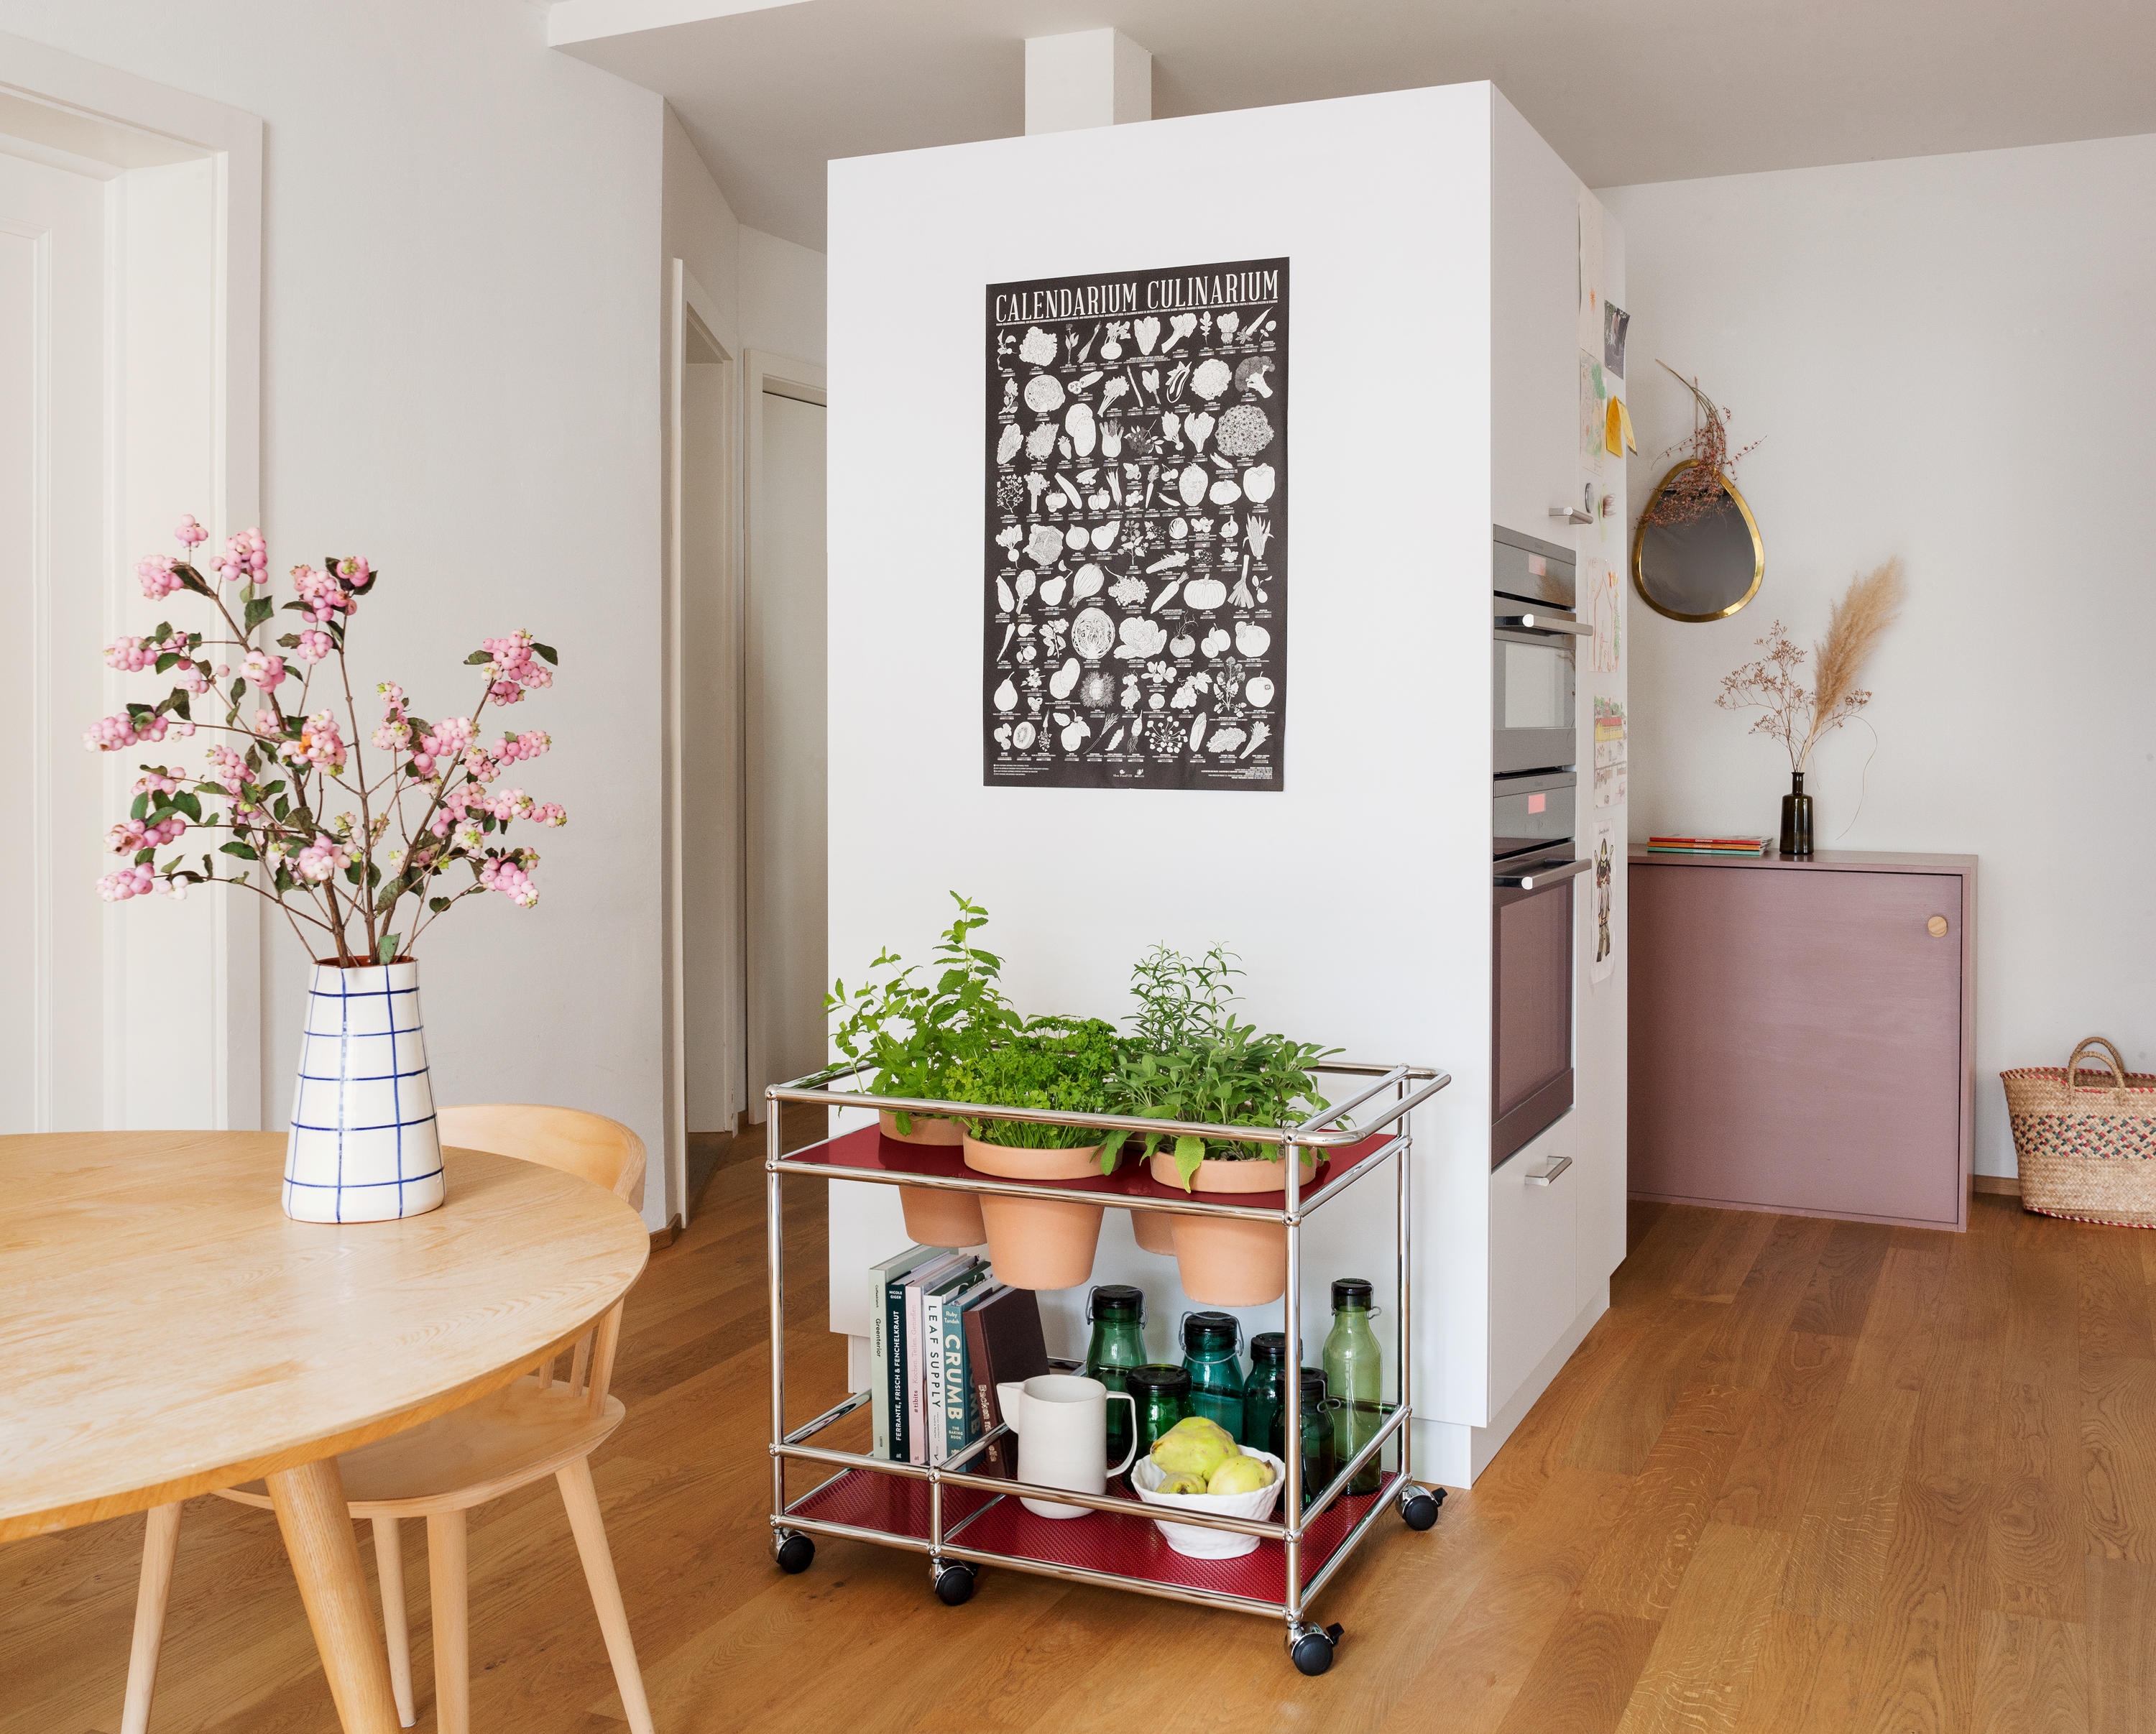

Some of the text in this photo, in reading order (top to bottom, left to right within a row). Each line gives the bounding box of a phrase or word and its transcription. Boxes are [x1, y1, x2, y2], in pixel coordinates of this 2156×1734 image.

[995, 269, 1279, 323] CALENDARIUM CULINARIUM
[929, 1305, 941, 1408] LEAF SUPPLY
[944, 1334, 963, 1420] CRUMB
[978, 1384, 990, 1420] Backen
